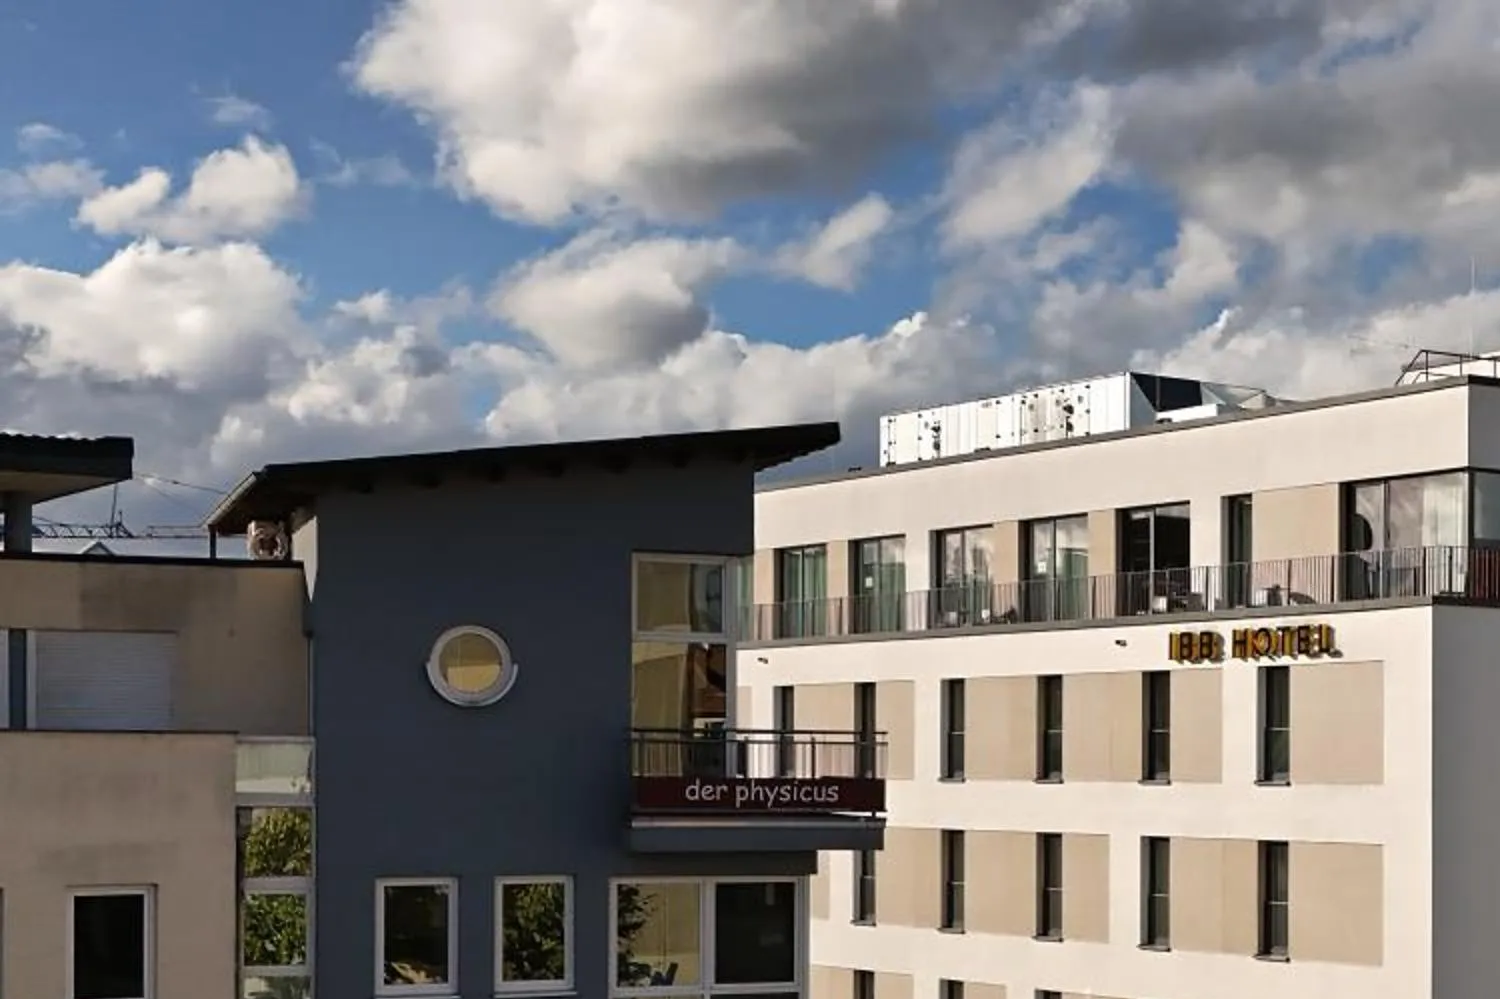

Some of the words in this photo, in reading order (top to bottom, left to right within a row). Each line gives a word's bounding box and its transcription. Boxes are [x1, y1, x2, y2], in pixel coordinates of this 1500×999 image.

[1169, 631, 1225, 664] IBB
[1232, 623, 1340, 662] HOTEL
[685, 778, 729, 801] der
[735, 778, 839, 808] physicus
